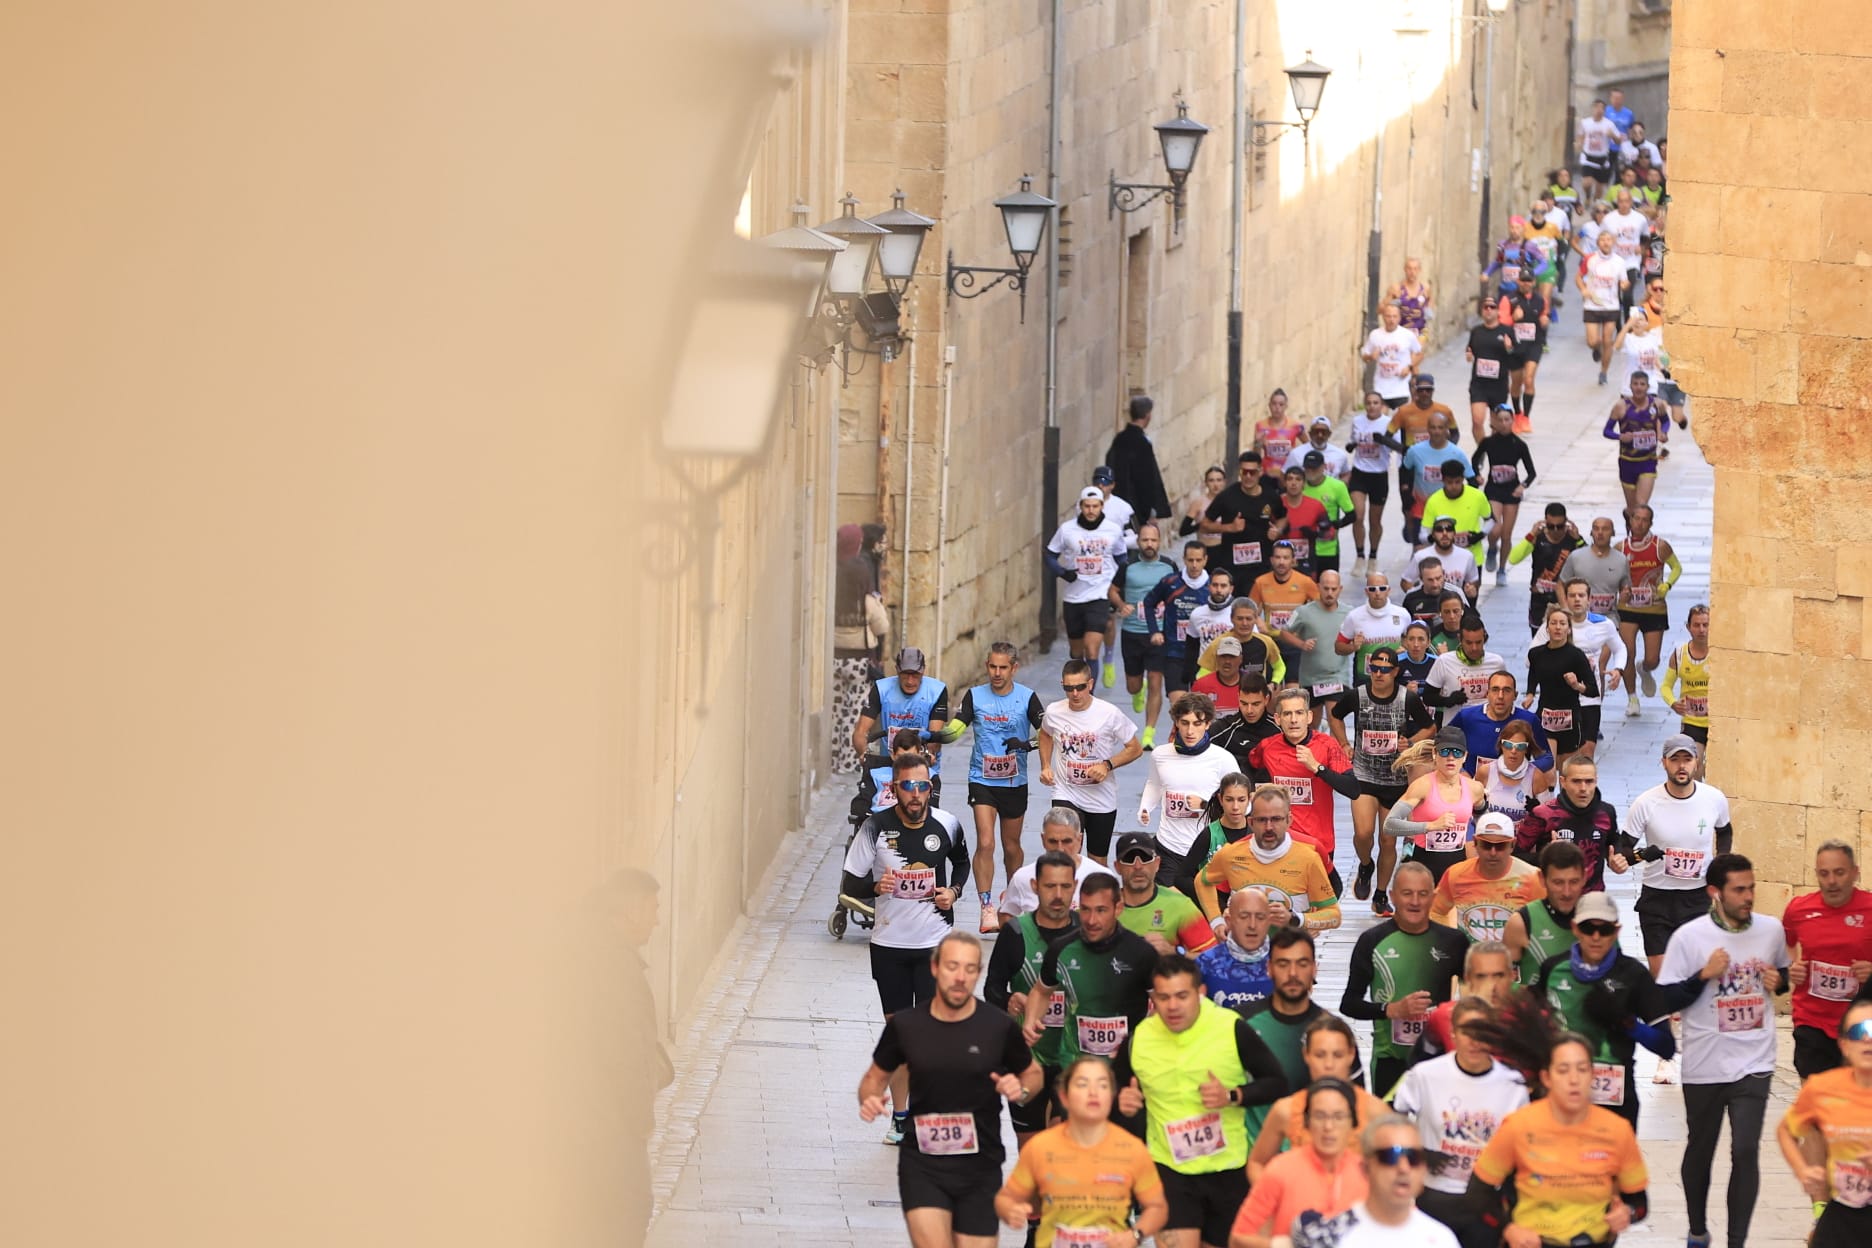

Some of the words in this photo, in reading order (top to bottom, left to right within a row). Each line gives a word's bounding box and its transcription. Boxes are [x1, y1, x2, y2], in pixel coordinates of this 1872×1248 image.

[1470, 684, 1481, 693] 23
[1370, 739, 1389, 748] 597
[983, 756, 1016, 764] bedunia
[990, 762, 1010, 772] 489
[1073, 769, 1089, 779] 56
[1275, 778, 1311, 787] bedunia
[1165, 792, 1186, 800] bedu
[1170, 800, 1190, 811] 39
[1435, 832, 1457, 843] 229
[1666, 850, 1705, 860] bedunia
[1673, 858, 1697, 871] 317
[891, 871, 934, 881] bedunia
[900, 880, 926, 892] 614
[1820, 975, 1847, 990] 281
[1728, 1007, 1755, 1021] 311
[1080, 1019, 1127, 1030] bedunia
[1402, 1020, 1422, 1034] 38
[1087, 1030, 1116, 1043] 380
[1591, 1077, 1611, 1092] 32
[916, 1117, 973, 1127] bedunia
[1167, 1112, 1221, 1136] bedunia
[930, 1127, 962, 1141] 238
[1183, 1126, 1214, 1148] 148
